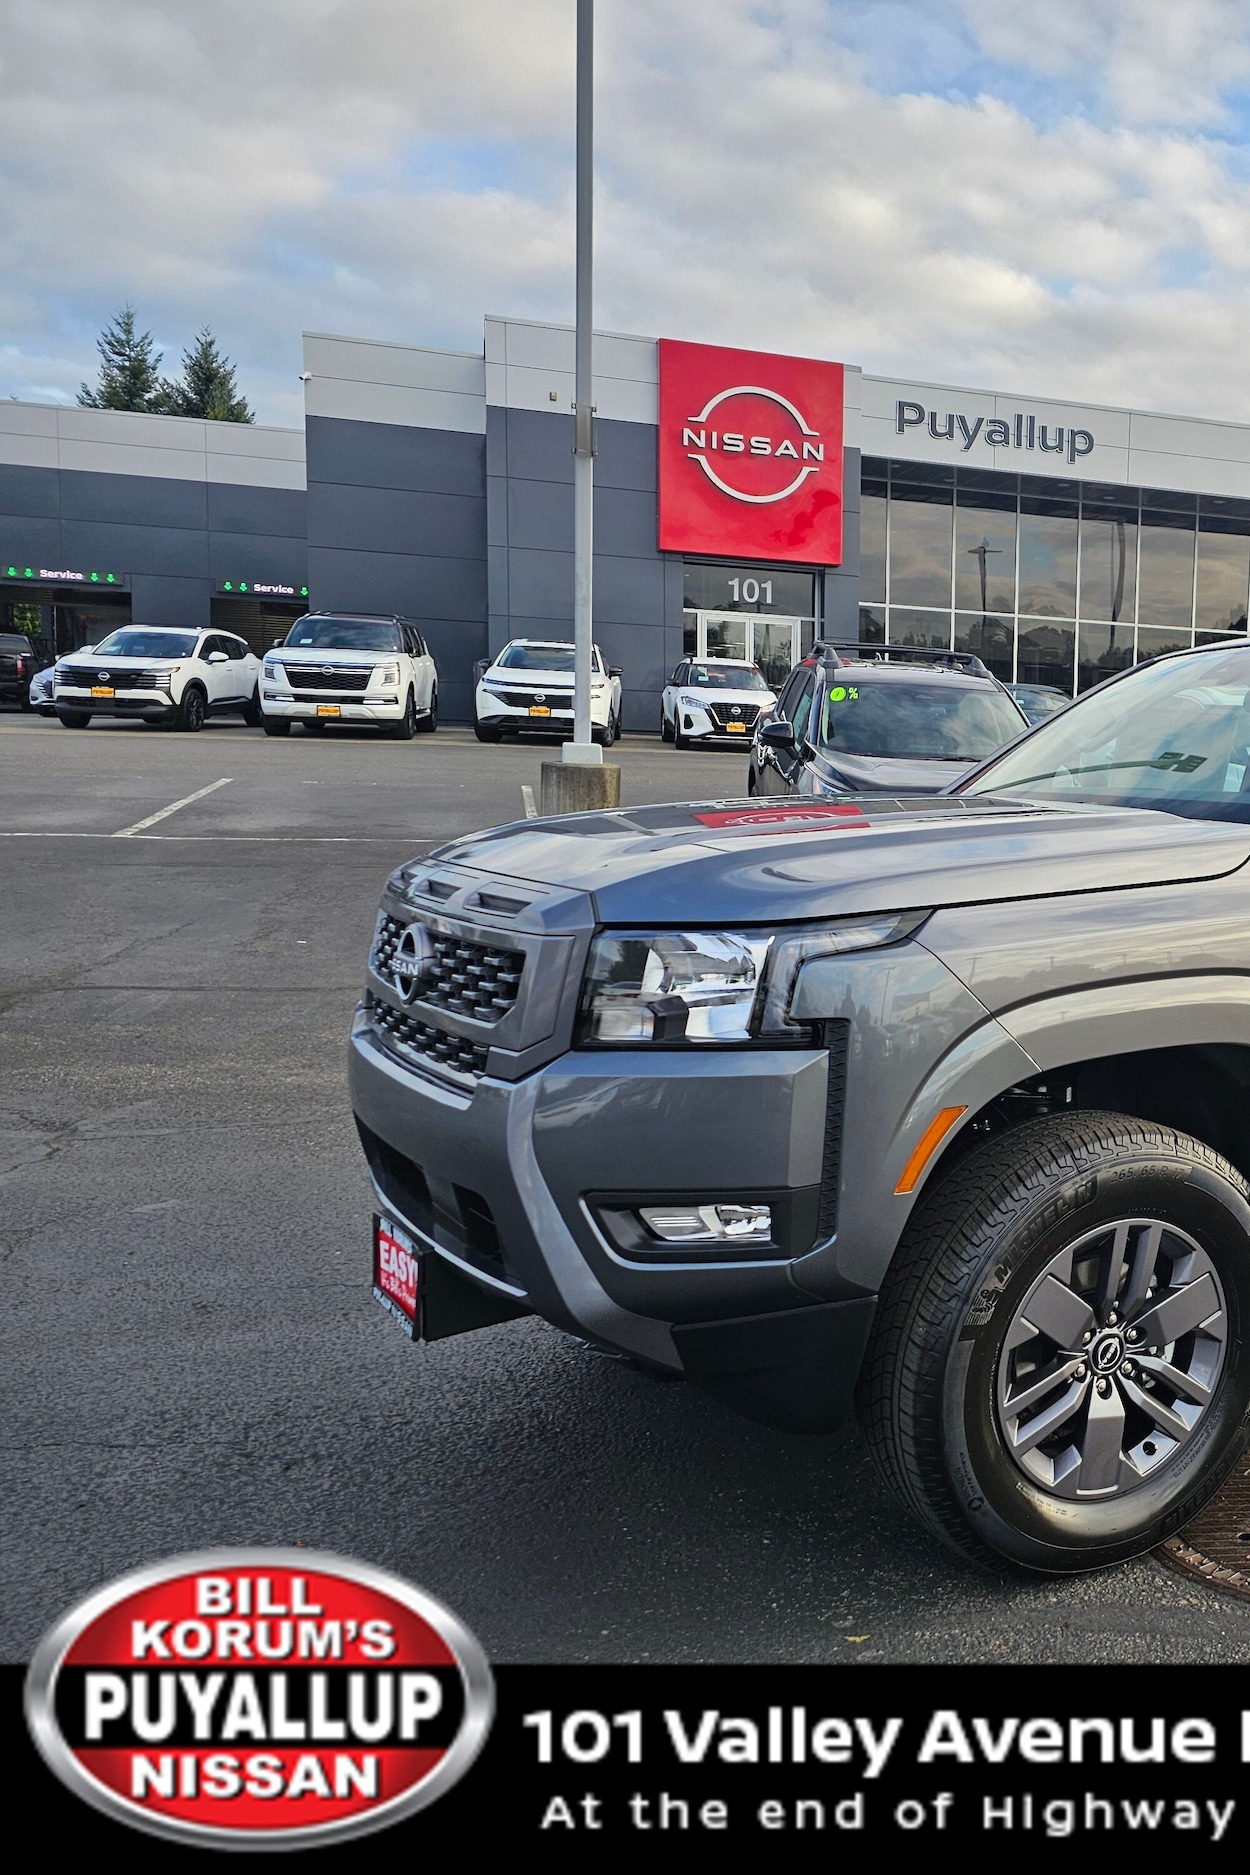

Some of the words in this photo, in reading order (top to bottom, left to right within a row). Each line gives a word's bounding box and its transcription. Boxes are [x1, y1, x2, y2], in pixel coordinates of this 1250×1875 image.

[682, 427, 825, 461] NISSAN
[895, 400, 1095, 464] Puyallup
[40, 569, 84, 580] Service
[253, 583, 295, 594] Service
[728, 577, 773, 604] 101
